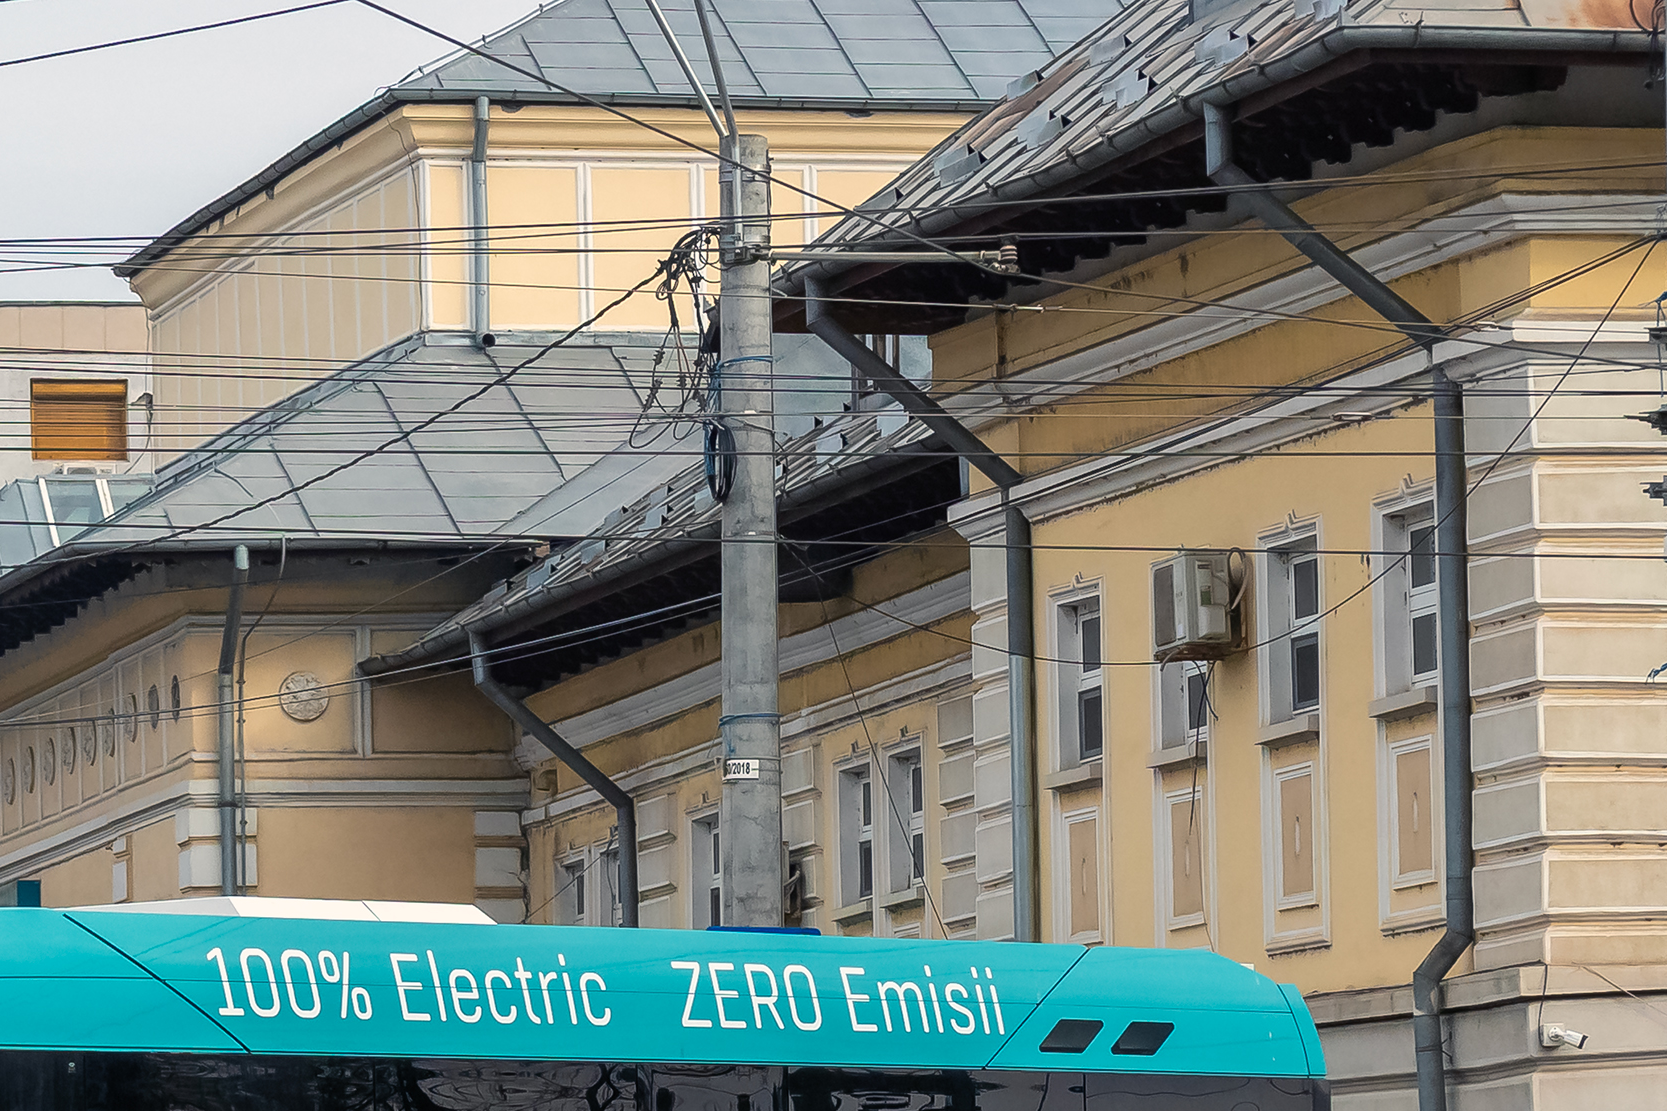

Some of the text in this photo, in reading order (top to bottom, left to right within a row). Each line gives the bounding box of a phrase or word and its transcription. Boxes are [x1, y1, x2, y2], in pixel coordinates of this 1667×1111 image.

[206, 946, 1007, 1035] 100% Electric ZERO Emisii
